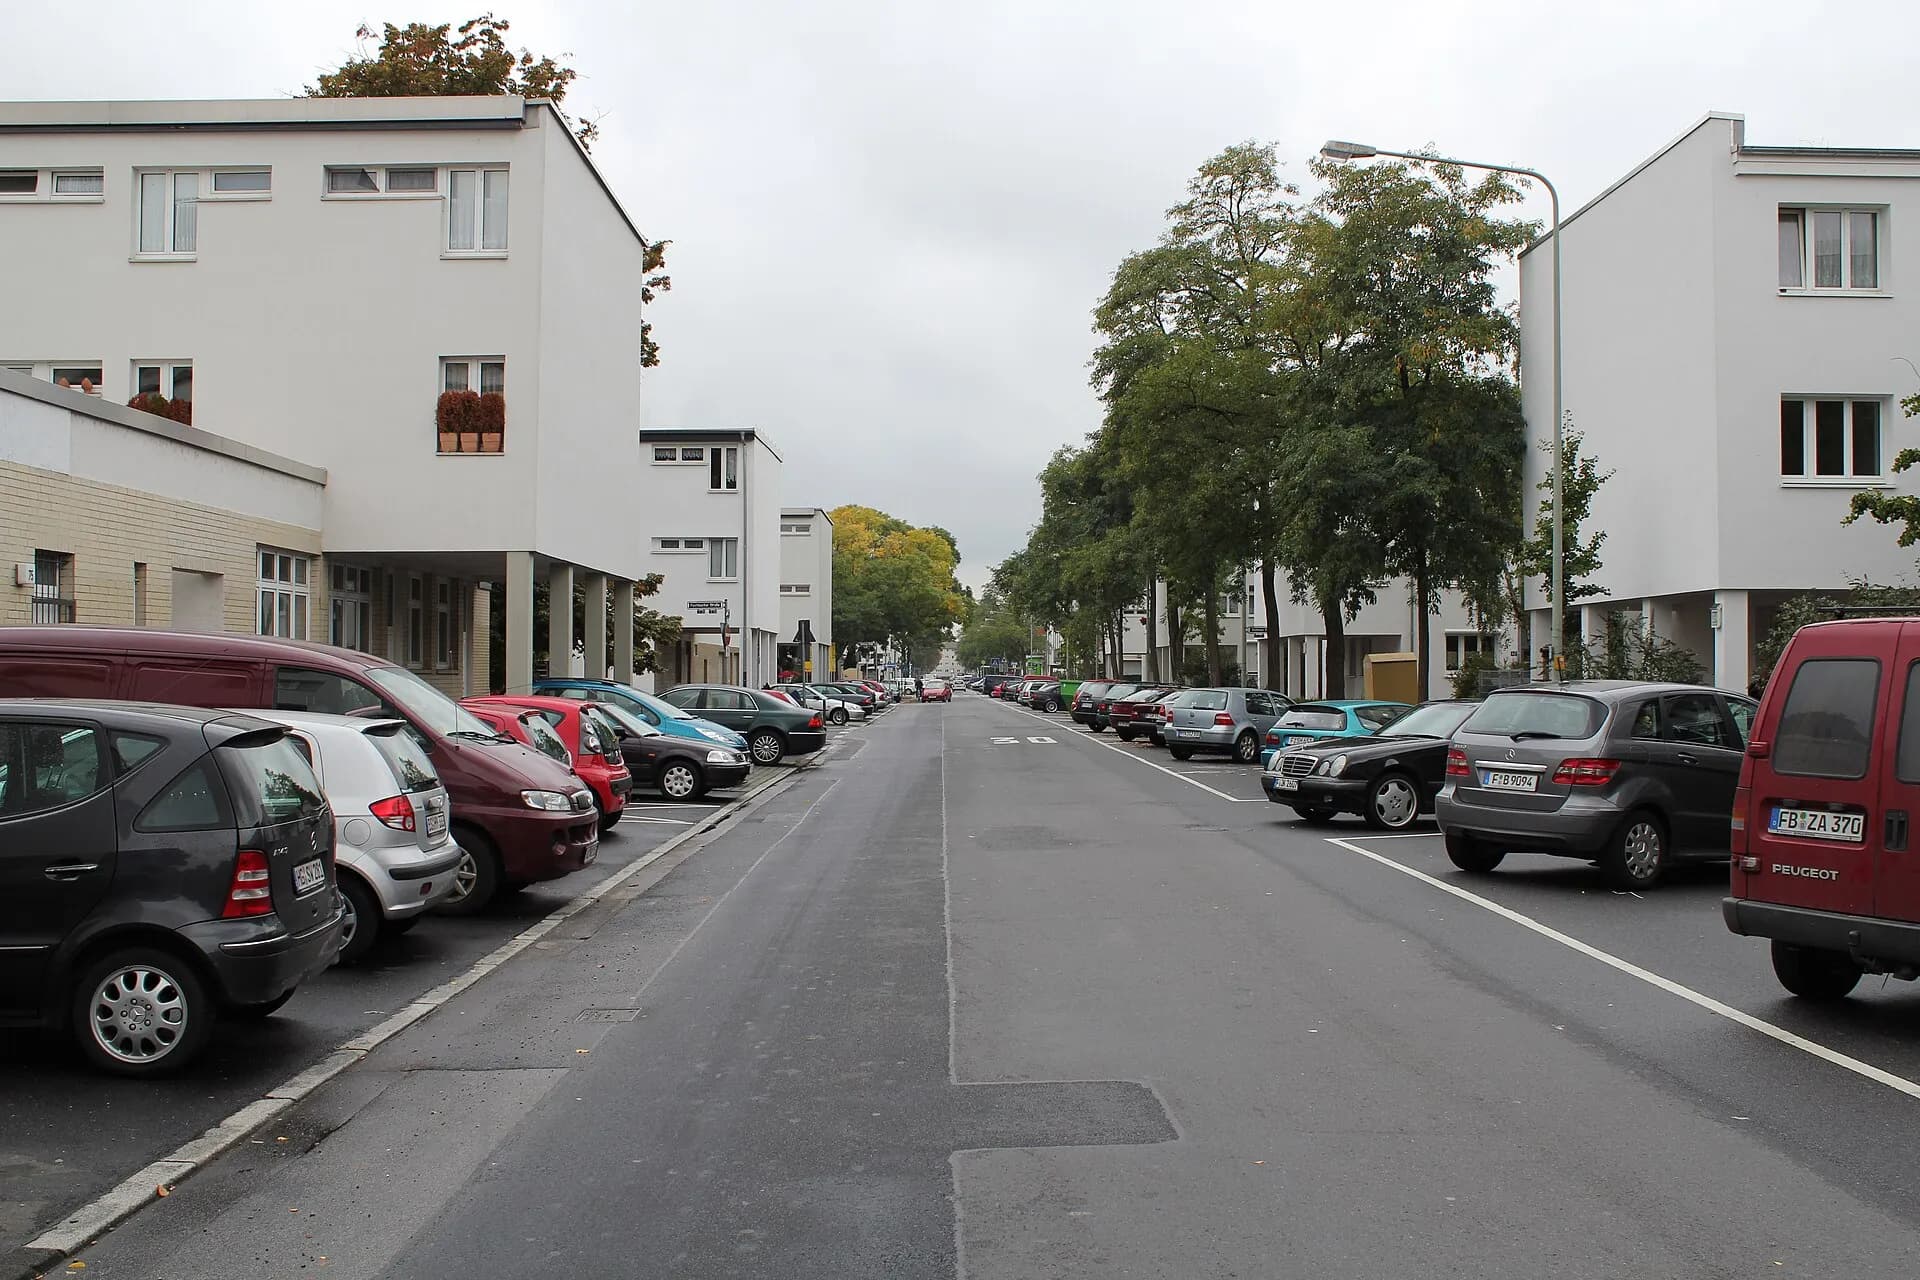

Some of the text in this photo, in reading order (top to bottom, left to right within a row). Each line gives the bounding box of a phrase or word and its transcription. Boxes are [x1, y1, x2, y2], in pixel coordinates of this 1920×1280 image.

[1778, 811, 1861, 835] FB ZA 370
[1772, 863, 1839, 881] PEUGEOT
